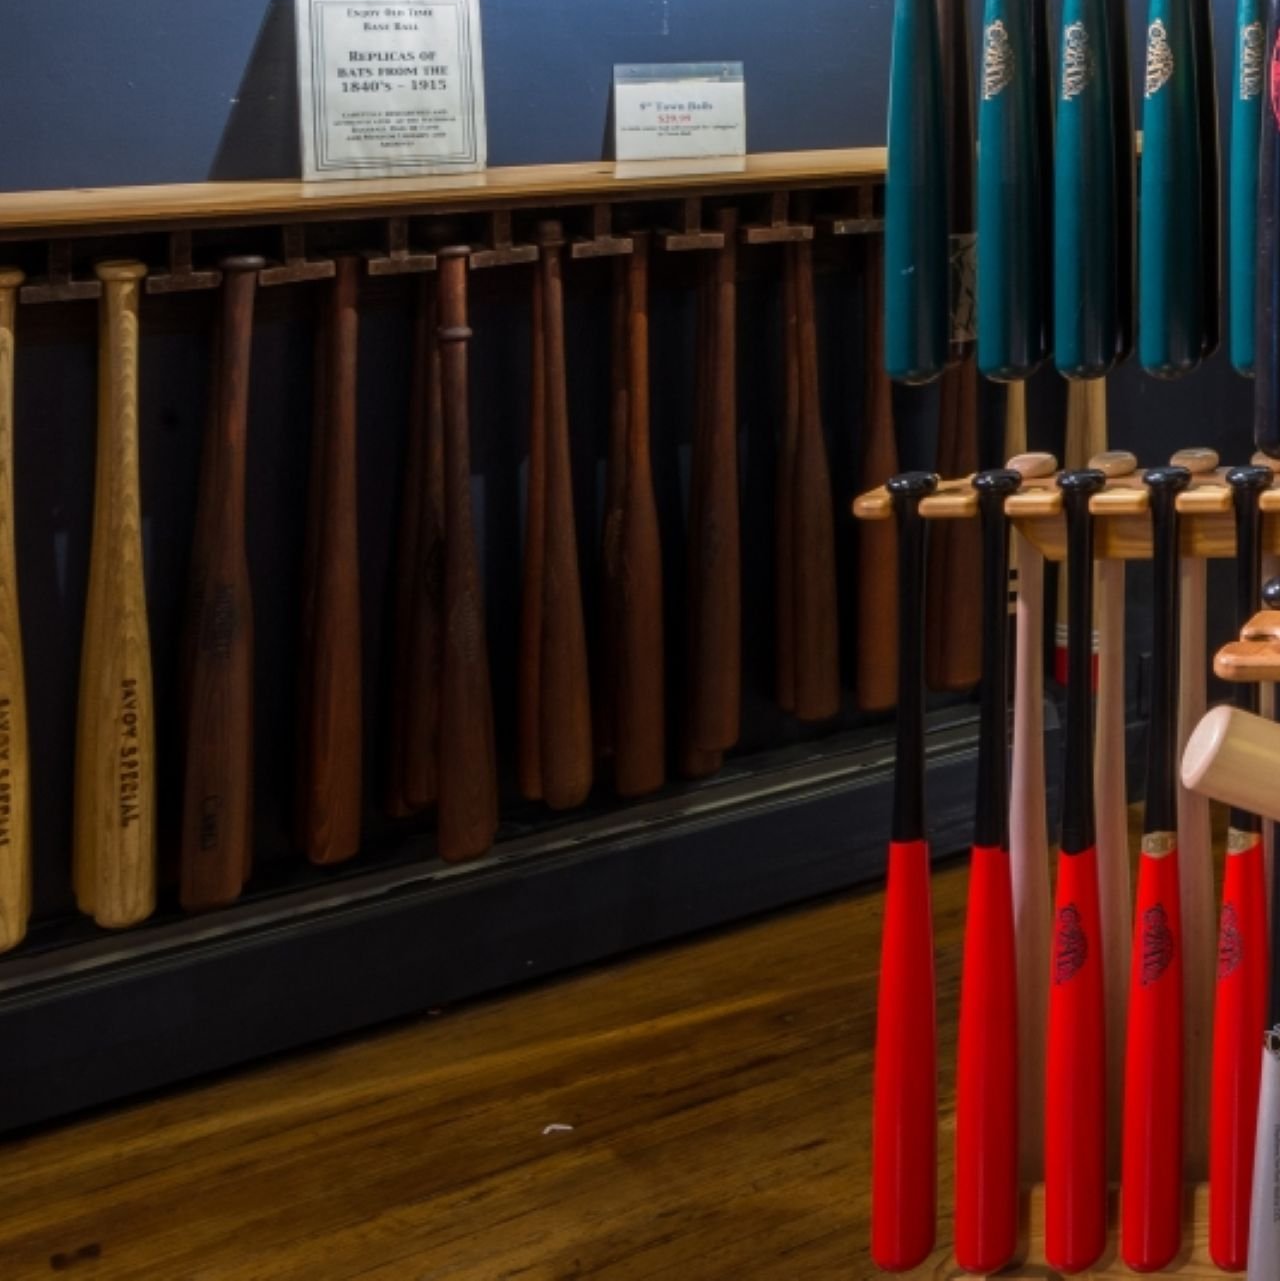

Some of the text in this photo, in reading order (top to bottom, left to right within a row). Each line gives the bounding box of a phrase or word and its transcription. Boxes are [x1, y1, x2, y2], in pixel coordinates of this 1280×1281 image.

[348, 50, 415, 62] REPLICAS
[377, 66, 418, 77] FROM
[422, 64, 449, 76] THE
[410, 79, 447, 91] 1915
[119, 746, 140, 829] SPECIAL
